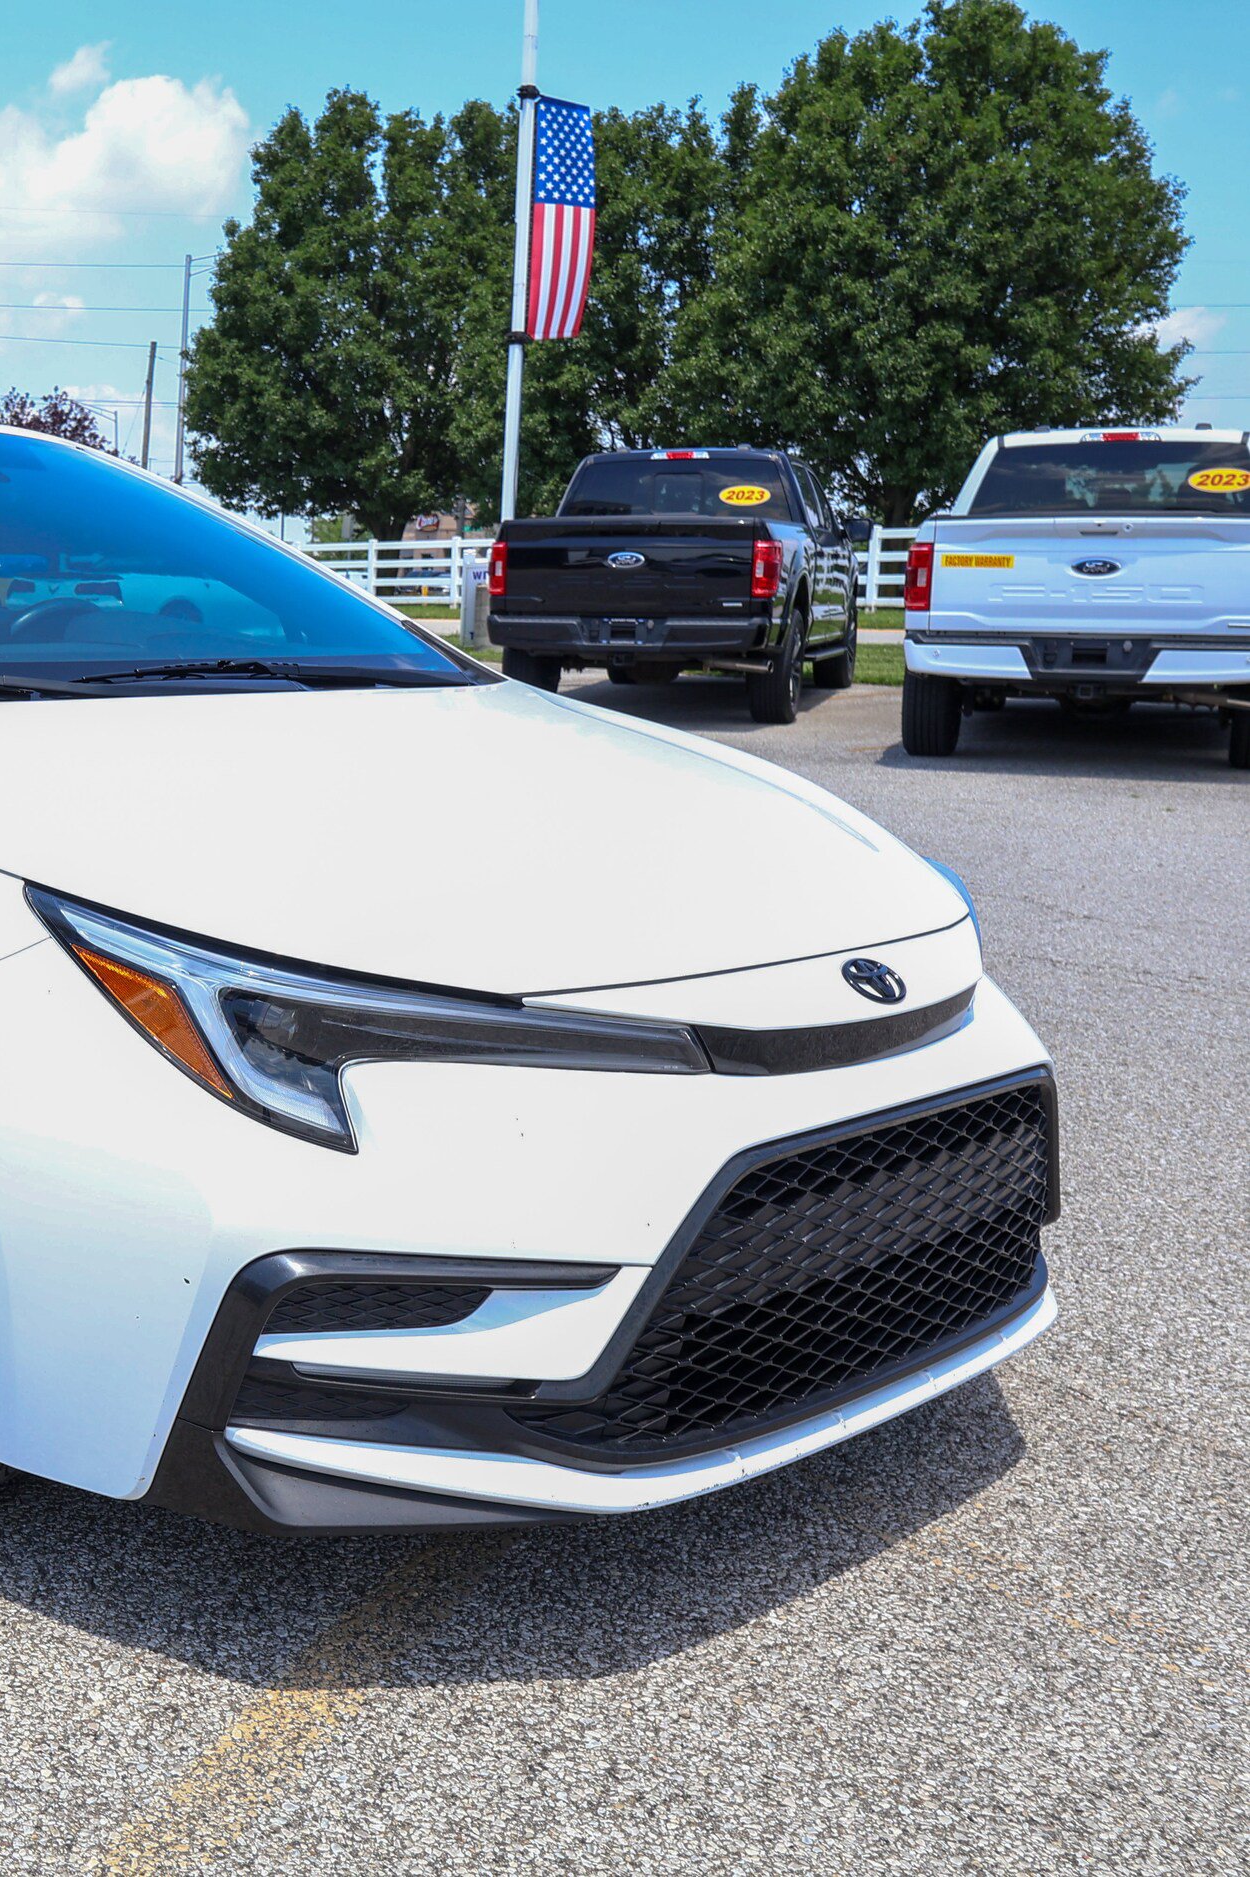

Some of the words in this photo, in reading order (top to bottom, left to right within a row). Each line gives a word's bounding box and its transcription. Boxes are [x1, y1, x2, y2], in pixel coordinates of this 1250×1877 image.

[1196, 473, 1250, 487] 2023
[725, 490, 766, 501] 2023
[944, 554, 973, 568] FACTORY
[974, 554, 1012, 568] WARRANTY
[988, 583, 1205, 604] F-150
